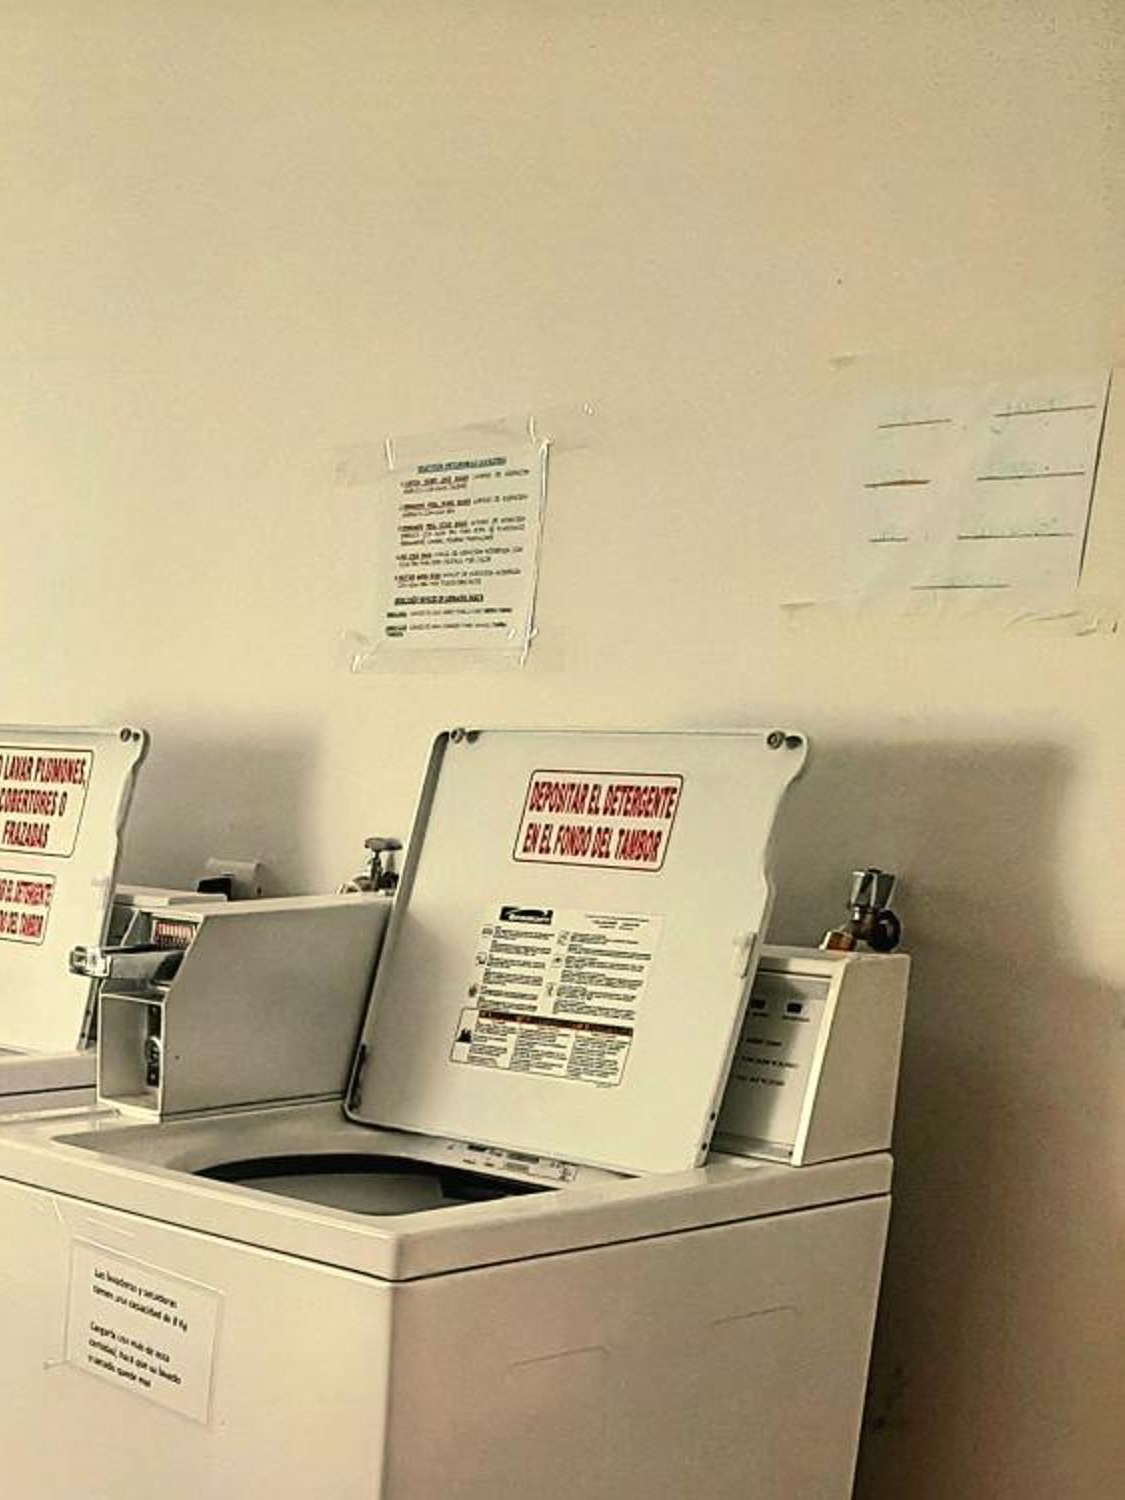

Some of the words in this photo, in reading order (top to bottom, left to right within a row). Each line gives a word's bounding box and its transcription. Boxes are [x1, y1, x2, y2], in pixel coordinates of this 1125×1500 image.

[4, 755, 33, 782] LAVAR
[59, 791, 67, 816] O
[529, 781, 589, 814] DEPOSITAR
[587, 783, 602, 815] EL
[602, 785, 677, 818] DETERGENTE
[2, 821, 49, 848] FRAZADAS
[523, 822, 541, 853] EN
[539, 824, 553, 854] EL
[553, 825, 592, 857] FONDO
[590, 827, 613, 858] DEL
[615, 828, 662, 862] TAMBOR
[128, 1300, 161, 1320] capacidad
[158, 1364, 182, 1385] lavado
